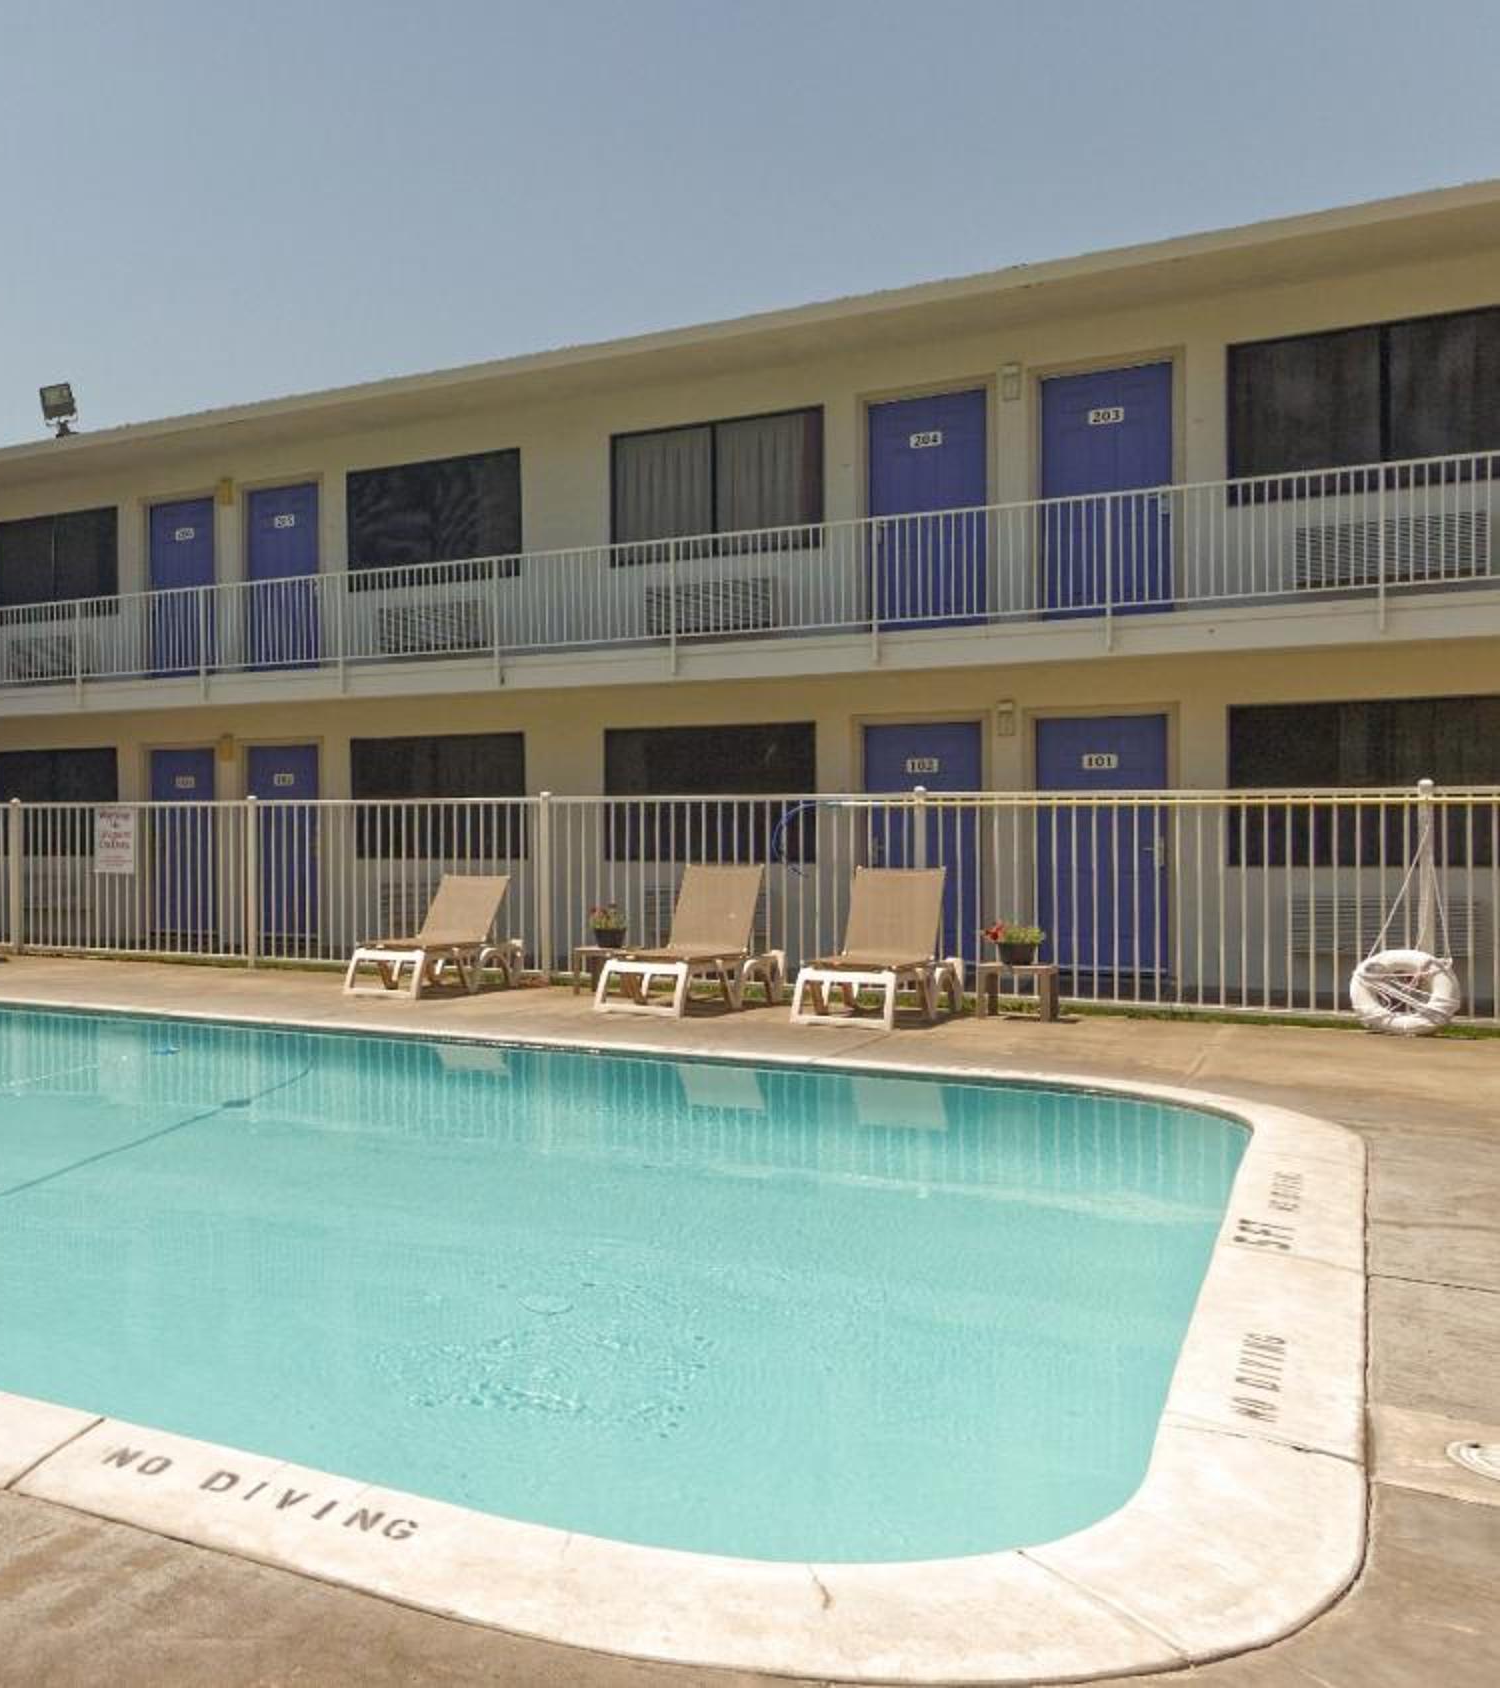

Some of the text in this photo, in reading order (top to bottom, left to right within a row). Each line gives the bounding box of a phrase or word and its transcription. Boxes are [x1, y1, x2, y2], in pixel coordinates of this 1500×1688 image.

[1092, 410, 1121, 423] 203
[913, 434, 939, 447] 204
[910, 759, 935, 771] 102
[1087, 755, 1113, 767] 101
[1233, 1218, 1296, 1250] 5FT
[1229, 1333, 1286, 1423] NO DIVING
[102, 1446, 421, 1543] NO DIVING
